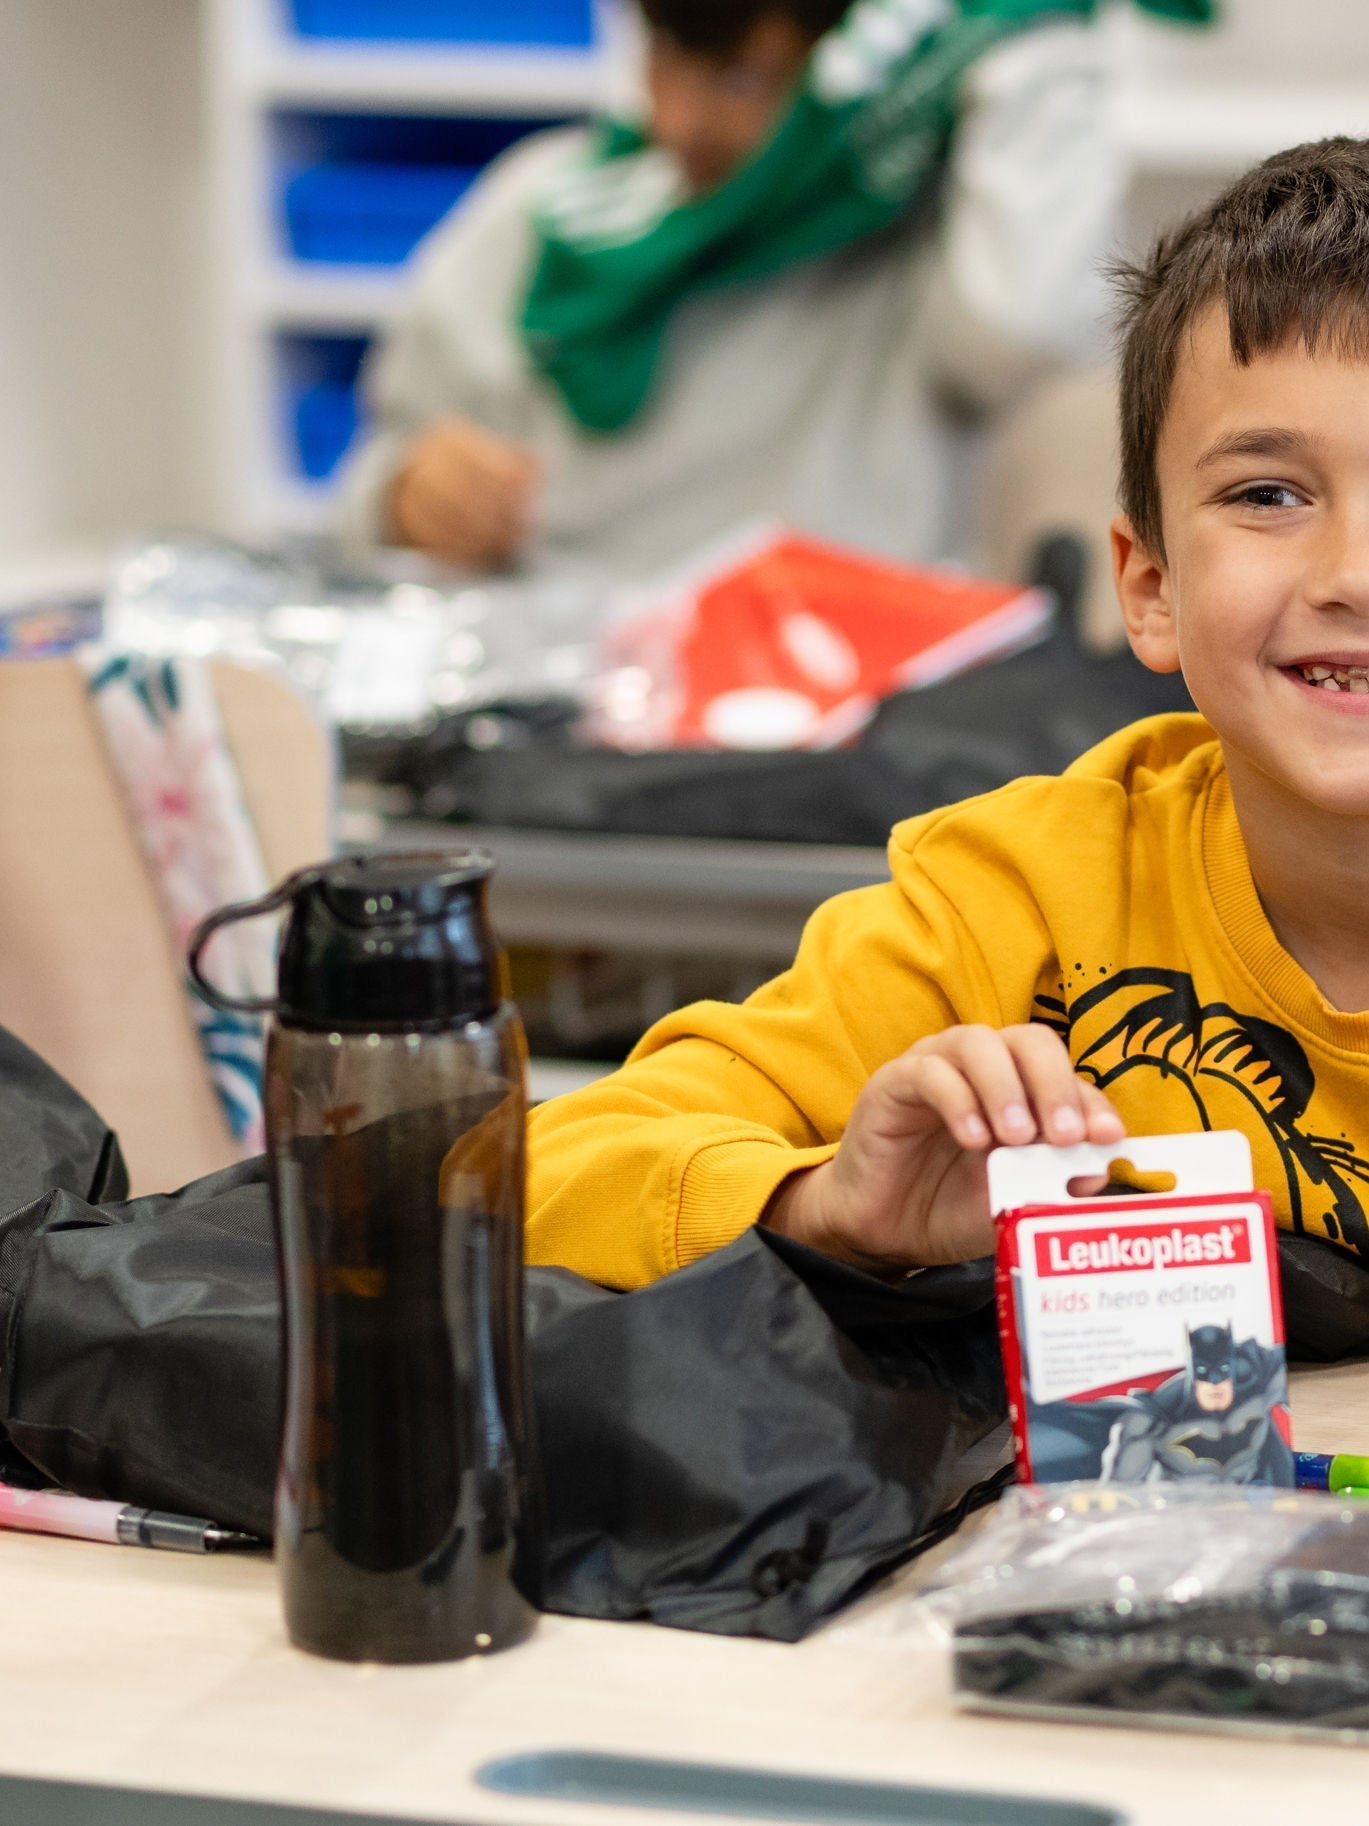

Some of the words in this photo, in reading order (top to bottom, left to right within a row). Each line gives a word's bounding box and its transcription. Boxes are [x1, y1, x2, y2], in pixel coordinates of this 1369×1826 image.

[1048, 1225, 1237, 1271] Leukoplast
[1040, 1290, 1090, 1314] kids
[1098, 1288, 1149, 1310] hero
[1156, 1280, 1236, 1307] edition
